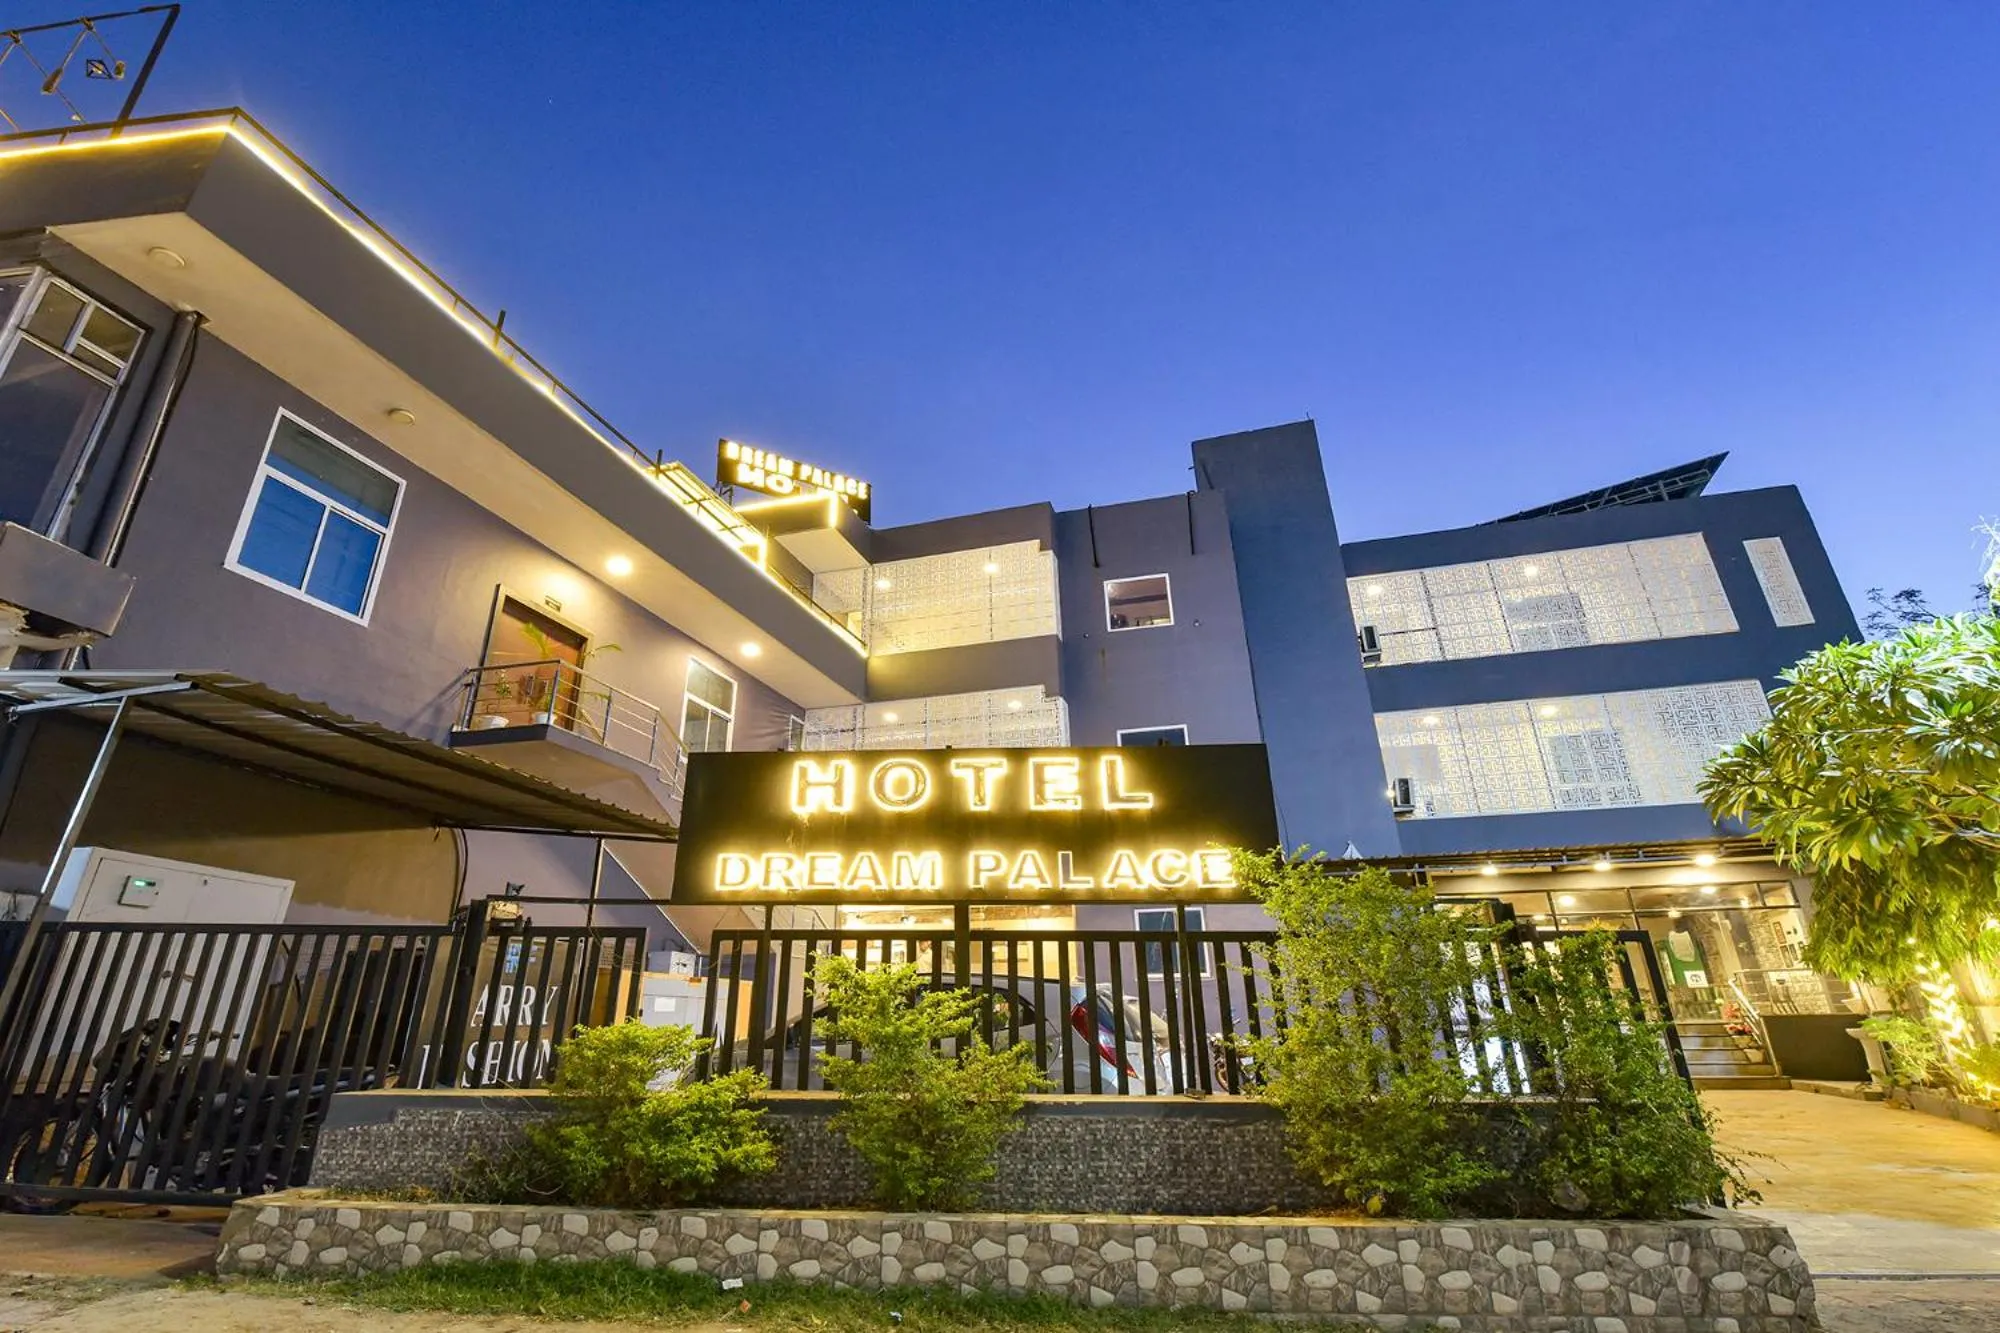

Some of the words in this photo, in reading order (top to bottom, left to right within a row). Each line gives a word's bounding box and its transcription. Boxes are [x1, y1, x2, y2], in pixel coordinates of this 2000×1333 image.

[801, 463, 867, 499] PALACE
[790, 755, 1154, 814] HOTEL
[714, 850, 943, 892] DREAM
[968, 848, 1239, 889] PALACE
